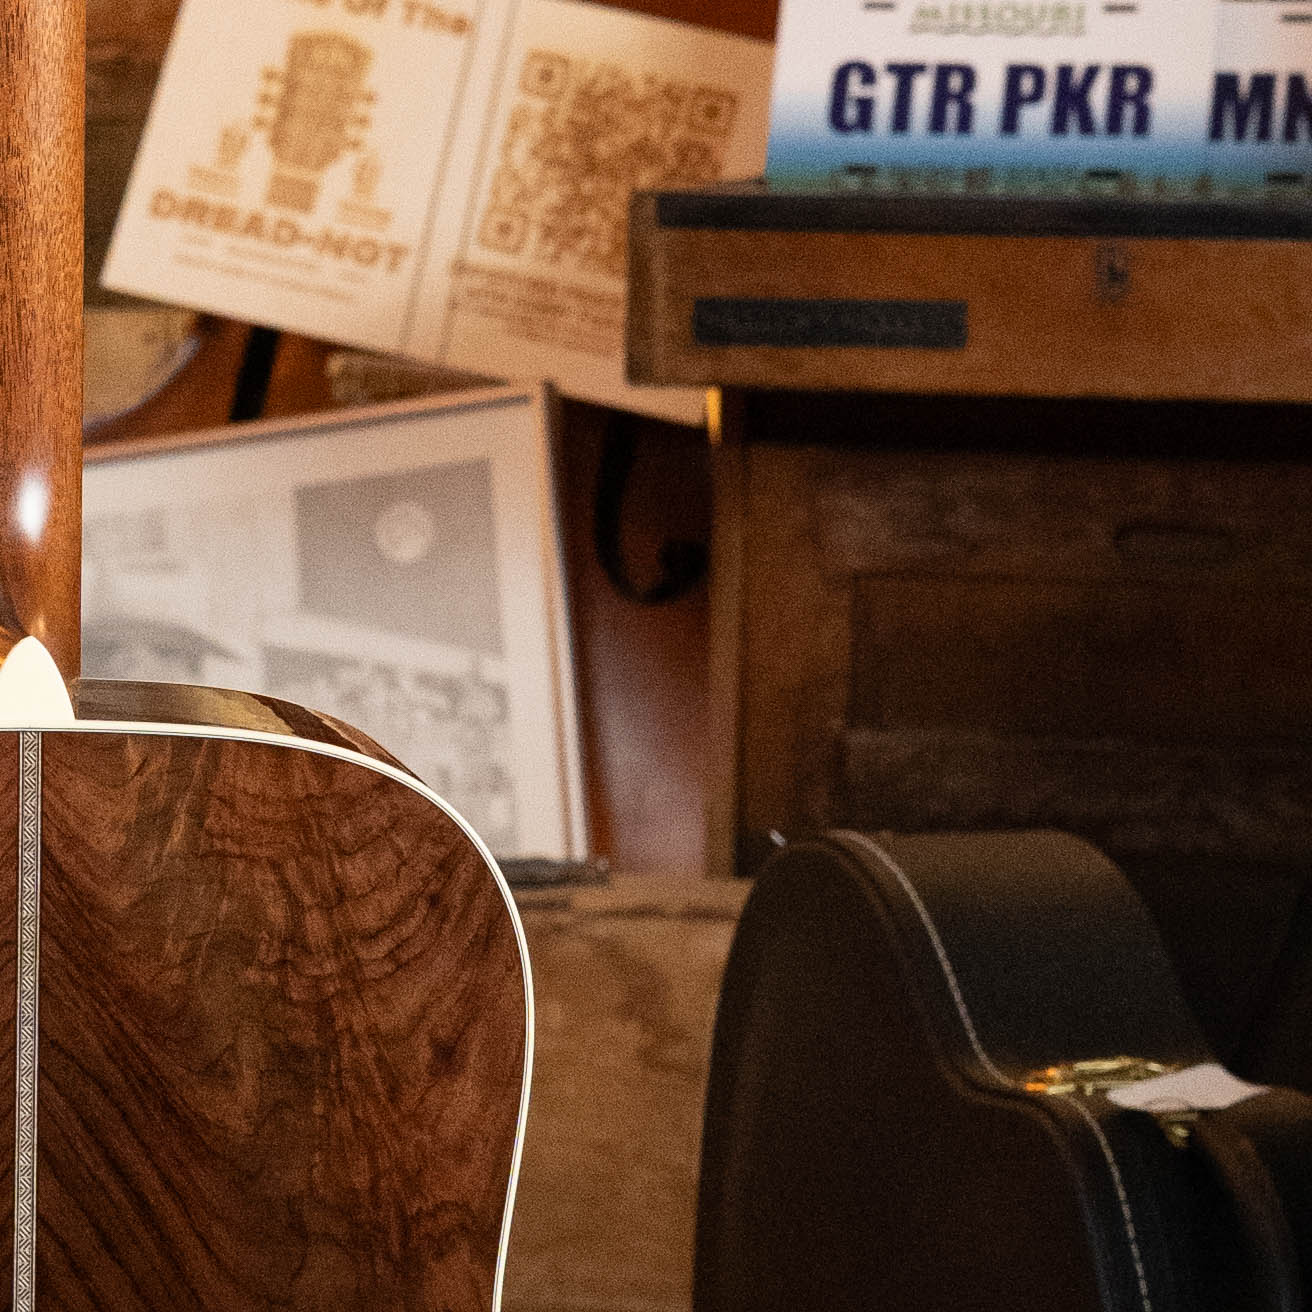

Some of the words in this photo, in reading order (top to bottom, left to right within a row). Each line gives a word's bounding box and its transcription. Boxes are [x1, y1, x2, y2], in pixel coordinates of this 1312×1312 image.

[828, 61, 978, 135] GTR
[999, 63, 1155, 139] PKR
[148, 189, 416, 274] DREAD-NOT
